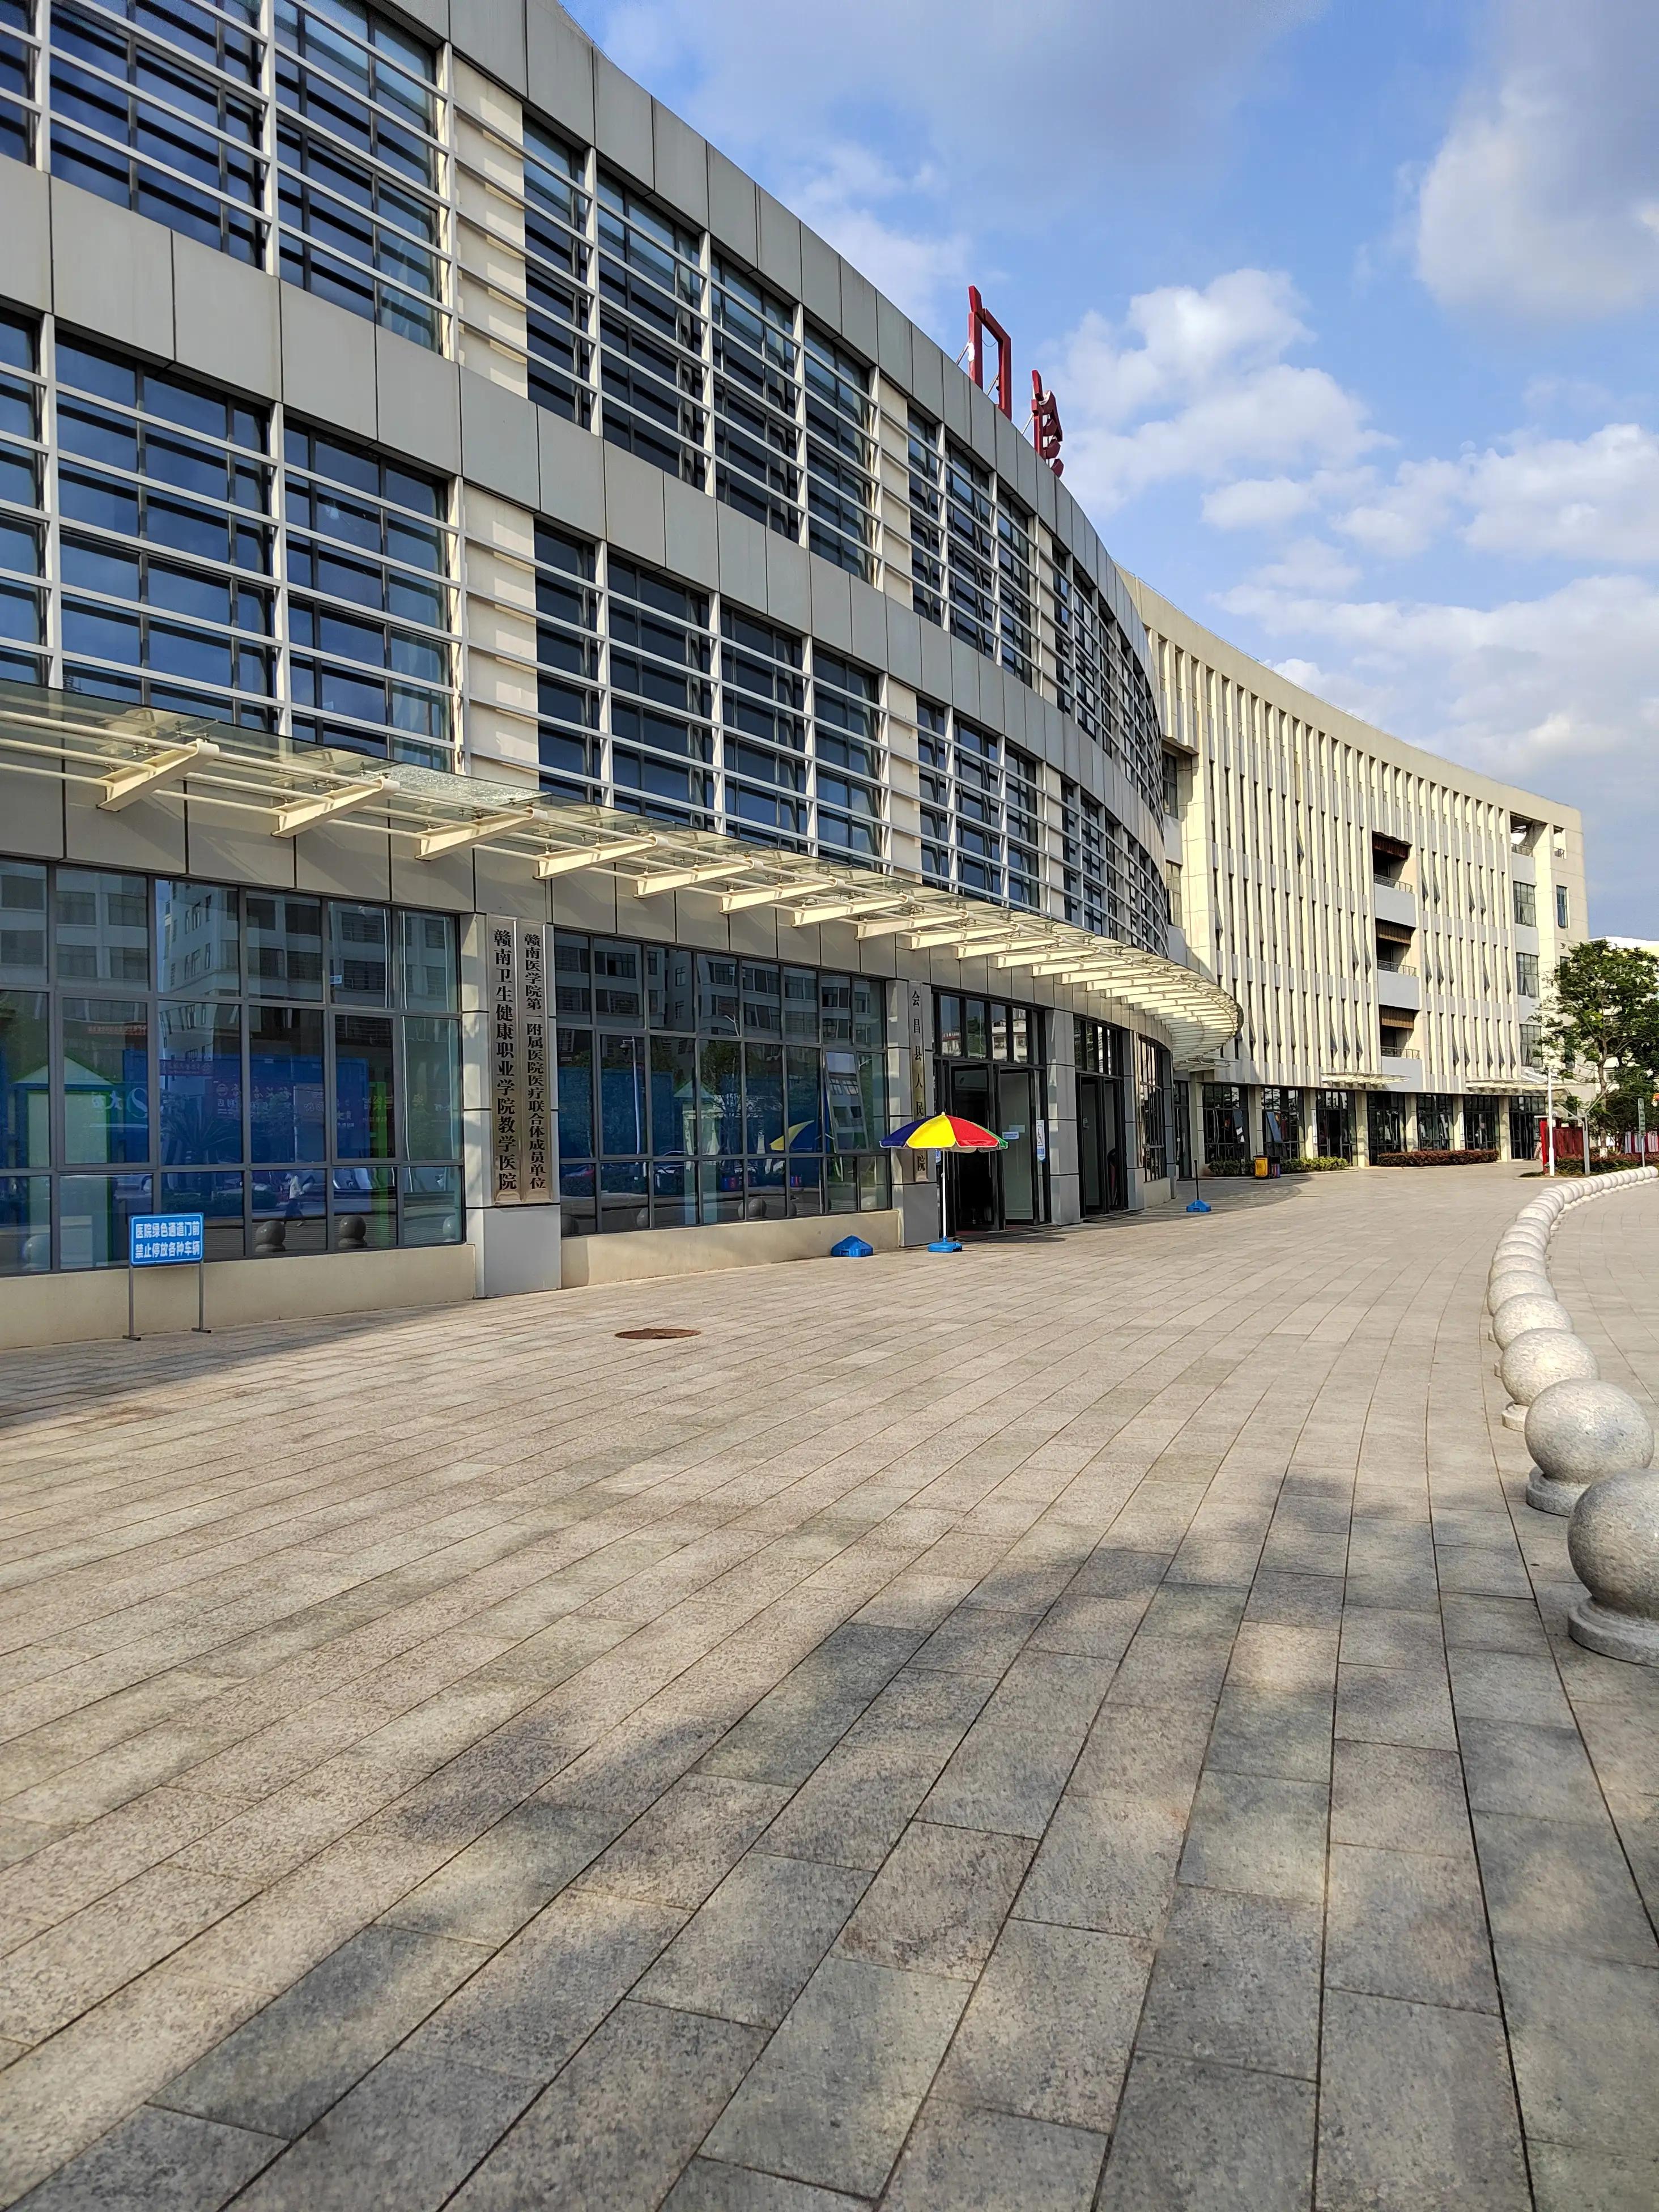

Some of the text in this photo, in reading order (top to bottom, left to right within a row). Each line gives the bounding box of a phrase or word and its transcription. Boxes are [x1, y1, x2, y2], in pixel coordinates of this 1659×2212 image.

[494, 929, 517, 1191] 赣南卫生健康职业学院教学医院
[524, 933, 546, 1190] 赣南医学院第一附属医院医疗联合体成员单位
[911, 990, 926, 1172] 会昌县人民院
[135, 1221, 200, 1239] 医院绿色通道门前
[135, 1241, 200, 1259] 禁止停放各种车辆
